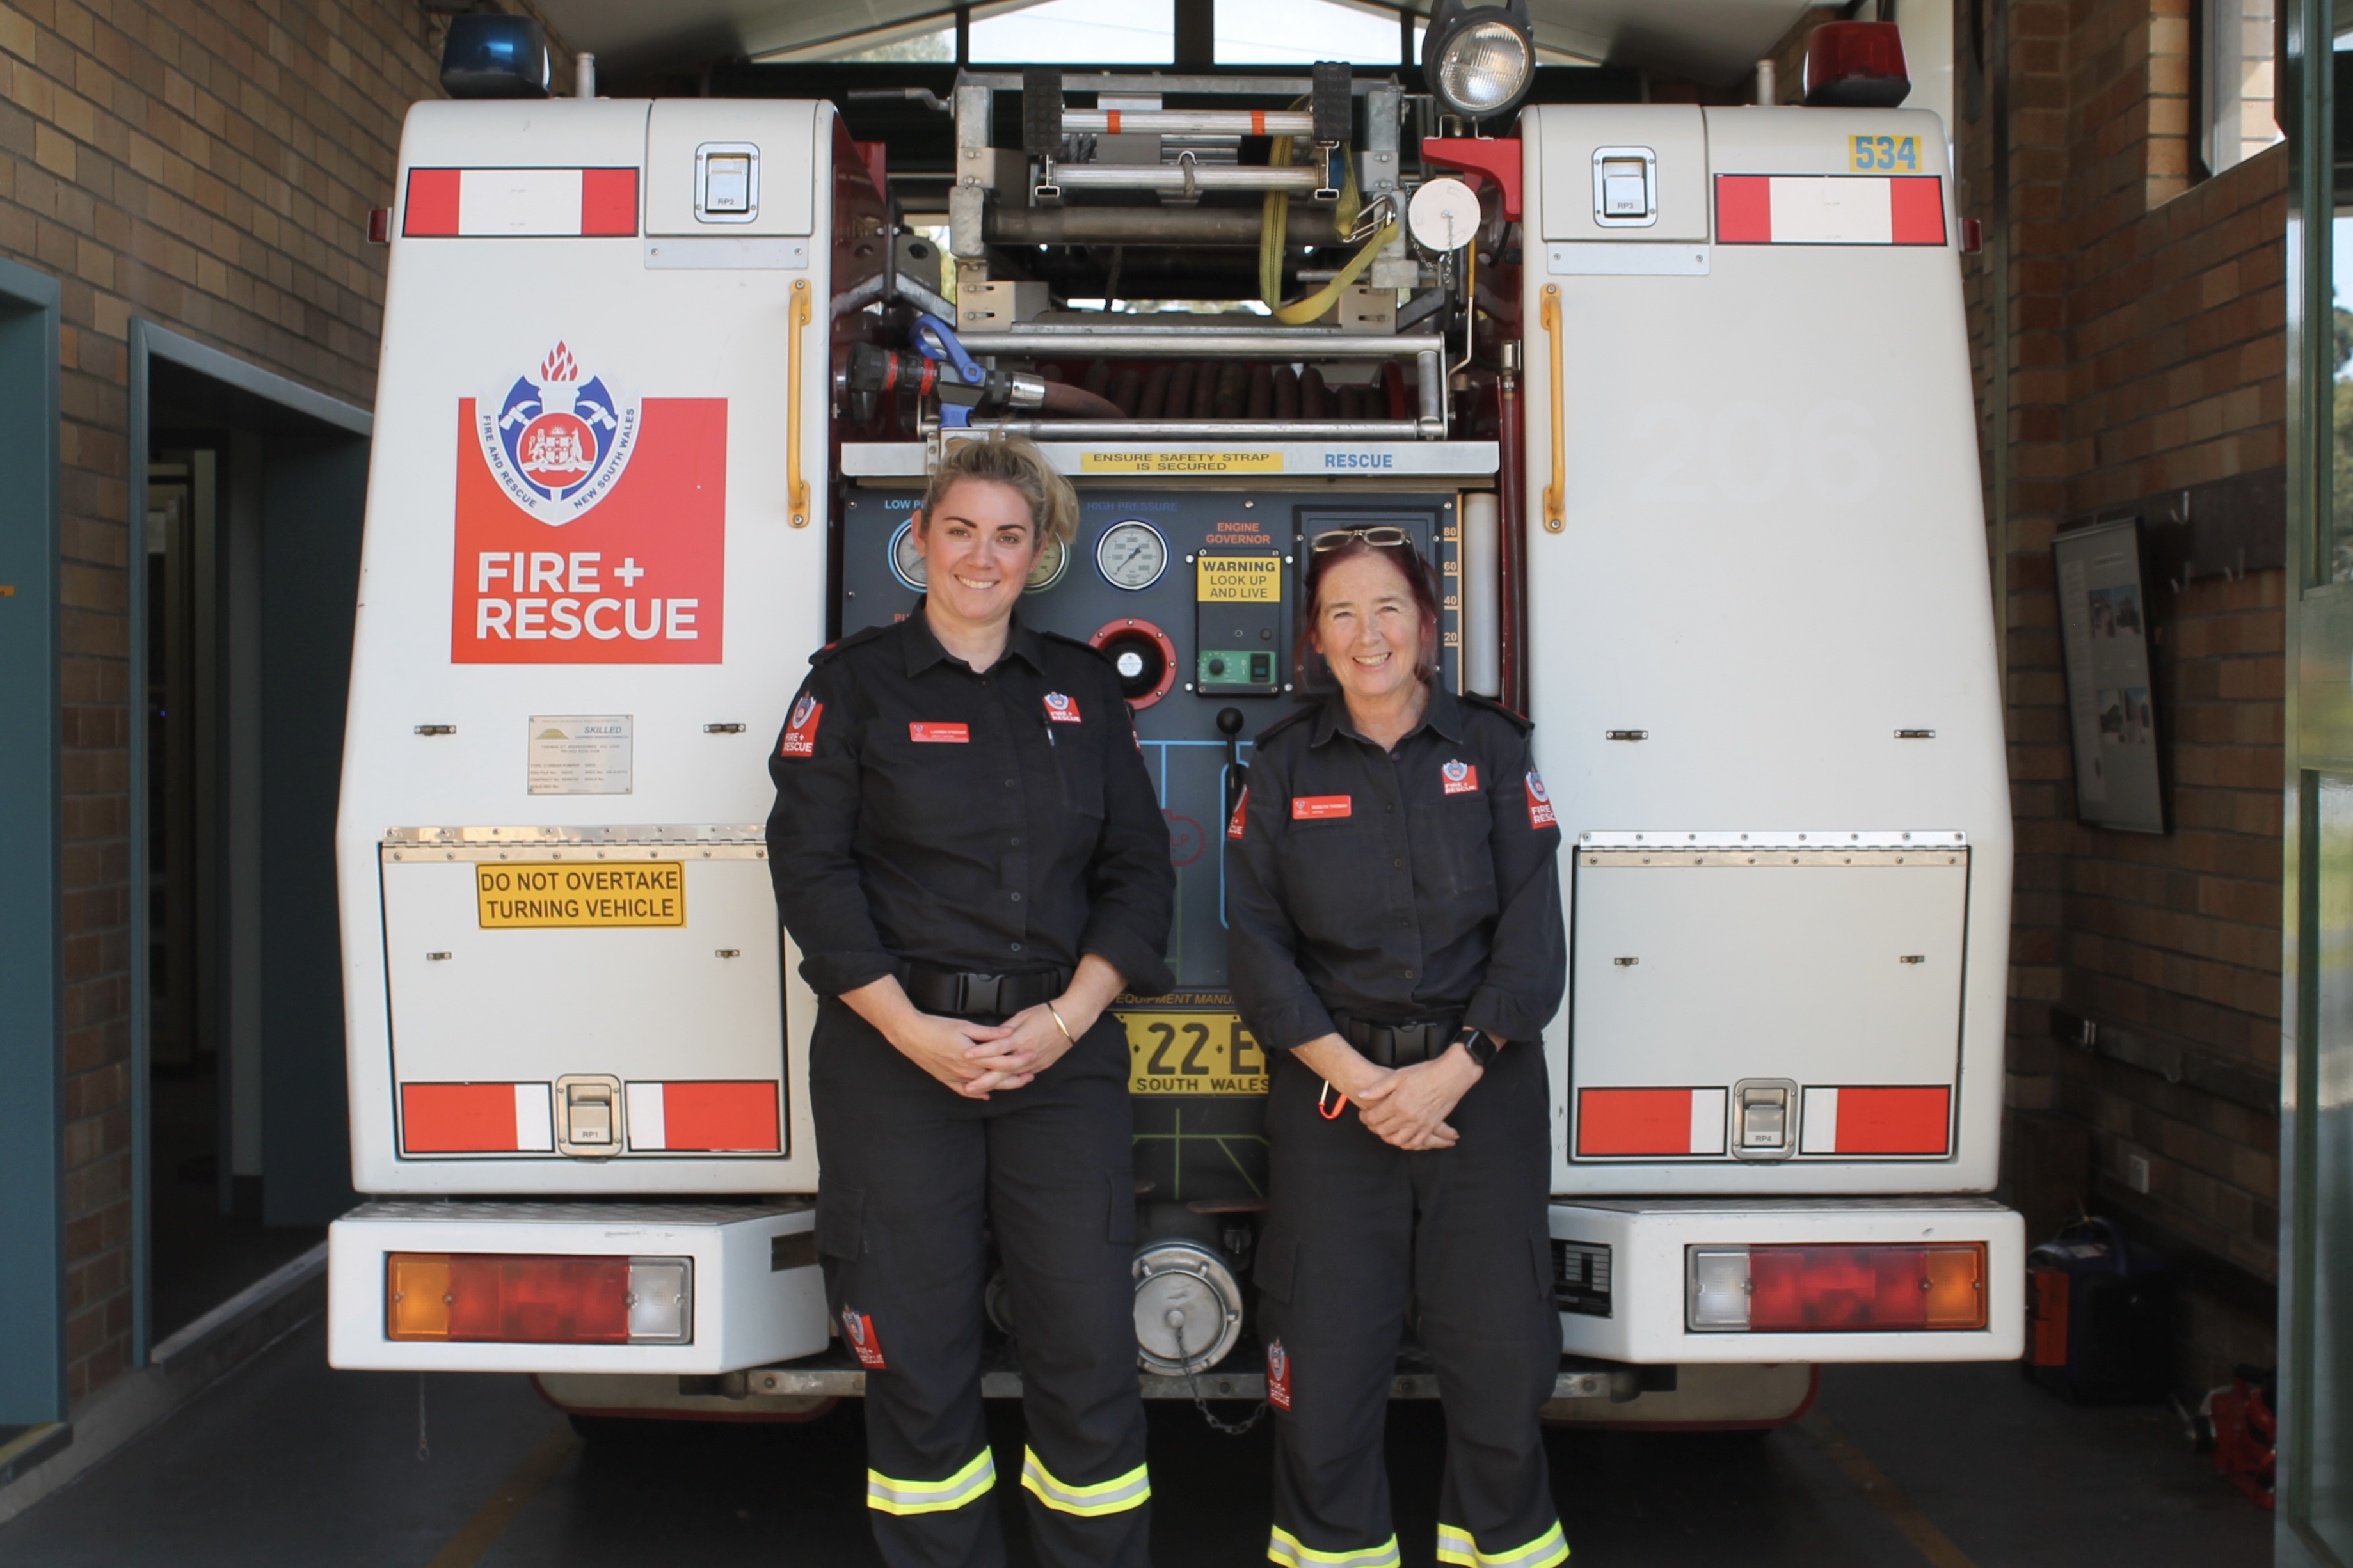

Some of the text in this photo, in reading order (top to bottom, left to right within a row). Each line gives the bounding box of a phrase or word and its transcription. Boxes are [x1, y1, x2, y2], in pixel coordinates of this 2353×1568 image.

[1856, 136, 1916, 170] 534
[483, 415, 538, 510] FIRE AND RESCUE
[573, 408, 635, 510] NEW SOUTH WALES
[1093, 454, 1152, 462] ENSURE
[1325, 454, 1392, 468] RESCUE
[884, 500, 911, 509] LOW
[1088, 502, 1178, 511] HIGH PRESSURE
[1217, 522, 1259, 532] ENGINE
[1444, 527, 1456, 536] 80
[1206, 534, 1270, 544] GOVERNOR
[1203, 562, 1275, 572] WARNING
[1444, 562, 1456, 571] 60
[478, 552, 601, 593] FIRE
[1210, 576, 1266, 585] LOOK UP
[1210, 588, 1268, 598] AND LIVE
[1444, 596, 1457, 605] 40
[476, 598, 698, 640] RESCUE
[1444, 632, 1457, 641] 20
[783, 742, 813, 752] RESCUE
[1445, 785, 1478, 794] RESCUE
[1531, 805, 1551, 815] FIRE
[1533, 813, 1556, 823] RESC
[481, 871, 678, 891] DO NOT OVERTAKE
[487, 899, 674, 919] TURNING VEHICLE
[1195, 994, 1234, 1004] MANU
[1137, 1078, 1269, 1091] SOUTH WALES
